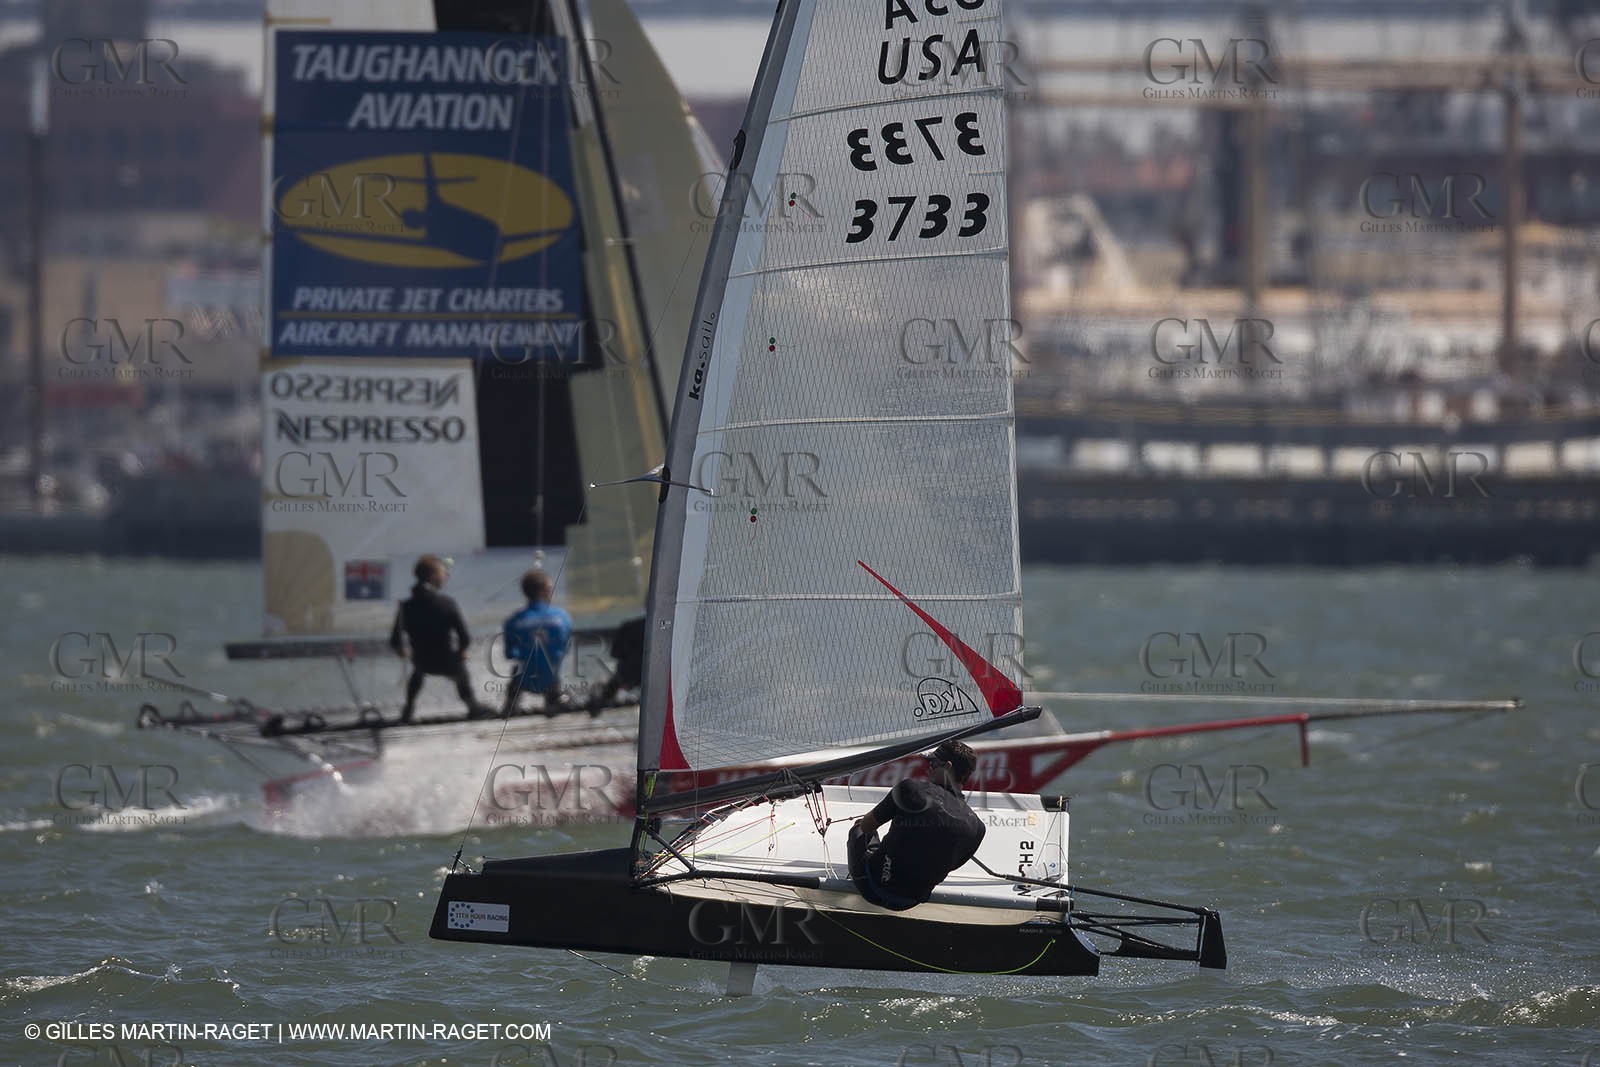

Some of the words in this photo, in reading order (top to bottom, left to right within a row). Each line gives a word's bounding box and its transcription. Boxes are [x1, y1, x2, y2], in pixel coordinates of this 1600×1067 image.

[292, 45, 559, 85] TAUGHANNOCK
[878, 29, 985, 84] USA
[349, 93, 515, 129] AVIATION
[845, 193, 990, 243] 3733
[293, 288, 392, 311] PRIVATE
[399, 288, 443, 312] JET
[449, 288, 564, 312] CHARTERS
[278, 321, 398, 345] AIRCRAFT
[405, 321, 576, 347] MANAGEMENT
[275, 410, 465, 446] NESPRESSO
